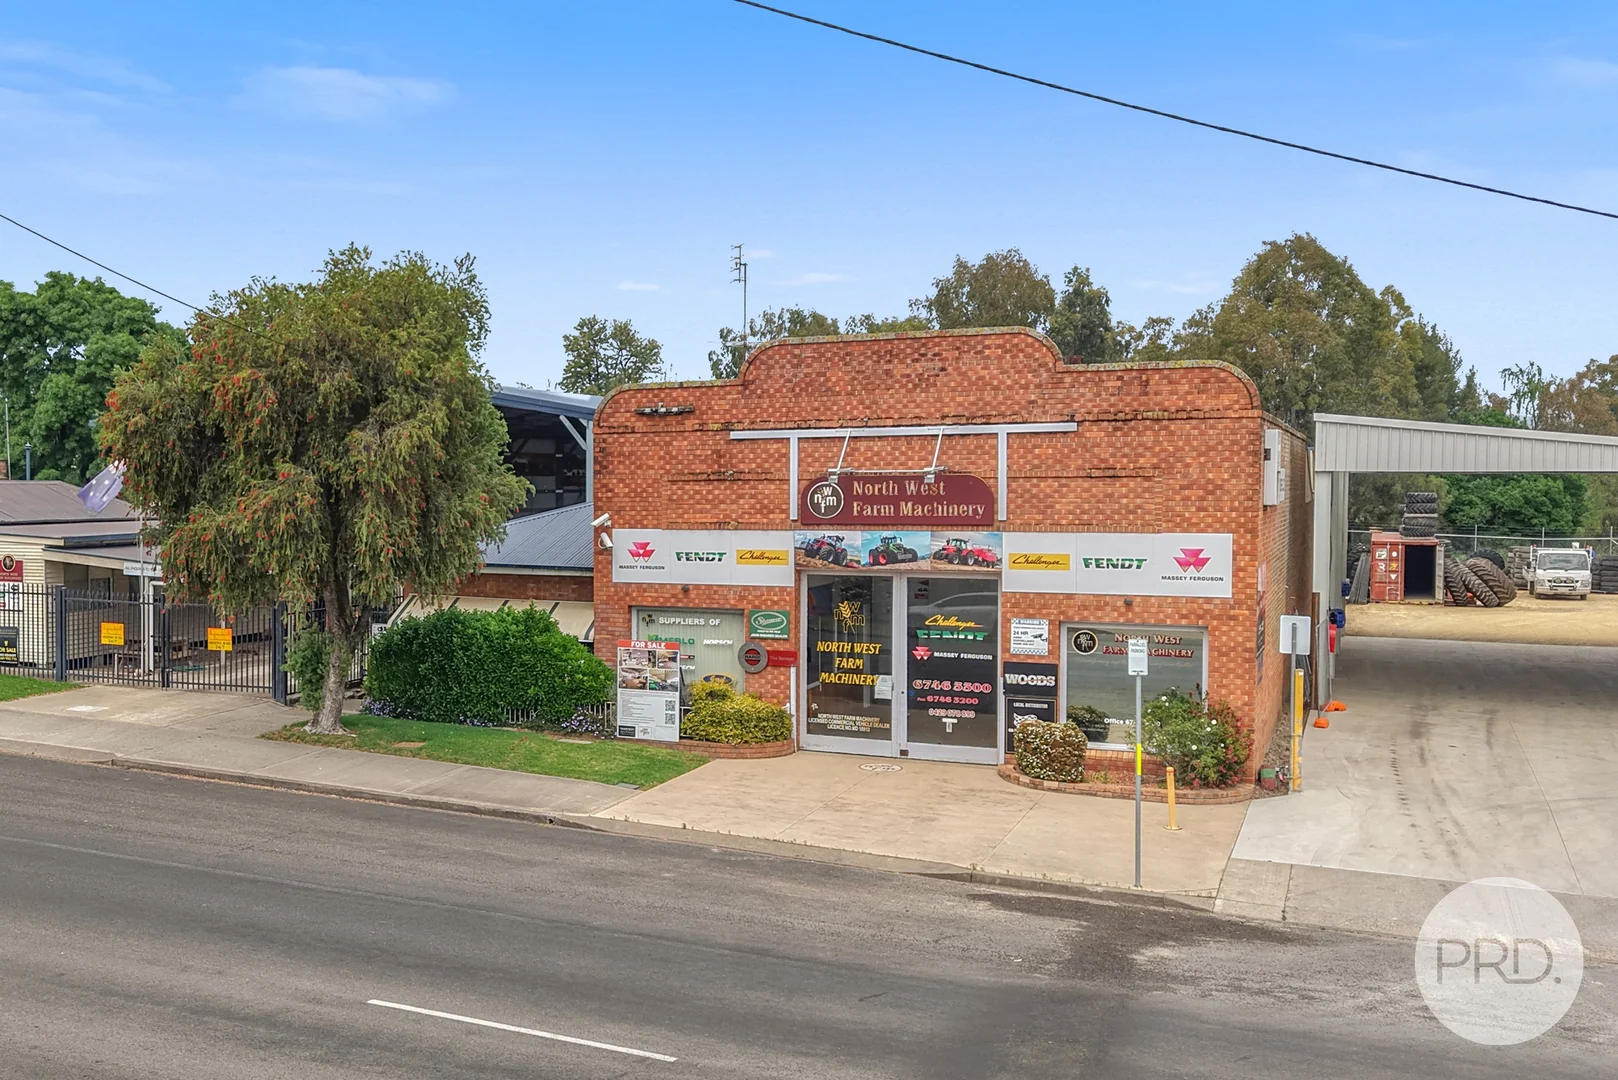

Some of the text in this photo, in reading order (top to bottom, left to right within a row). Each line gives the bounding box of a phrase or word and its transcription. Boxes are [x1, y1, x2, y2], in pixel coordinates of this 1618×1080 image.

[852, 480, 946, 496] North West
[852, 501, 986, 519] Farm Machinery
[675, 552, 727, 562] FENDT
[739, 550, 787, 564] Challenger
[1012, 554, 1068, 568] Challenger
[1082, 557, 1148, 570] FENDT
[658, 616, 721, 626] SUPPLIERS OF
[924, 614, 984, 630] Challenger
[1153, 634, 1182, 645] WEST
[816, 641, 882, 654] NORTH WEST
[1148, 648, 1194, 658] CHINERY
[834, 658, 864, 670] FARM
[819, 672, 878, 686] MACHINERY
[912, 679, 952, 691] 6746
[1004, 673, 1056, 686] WOODS
